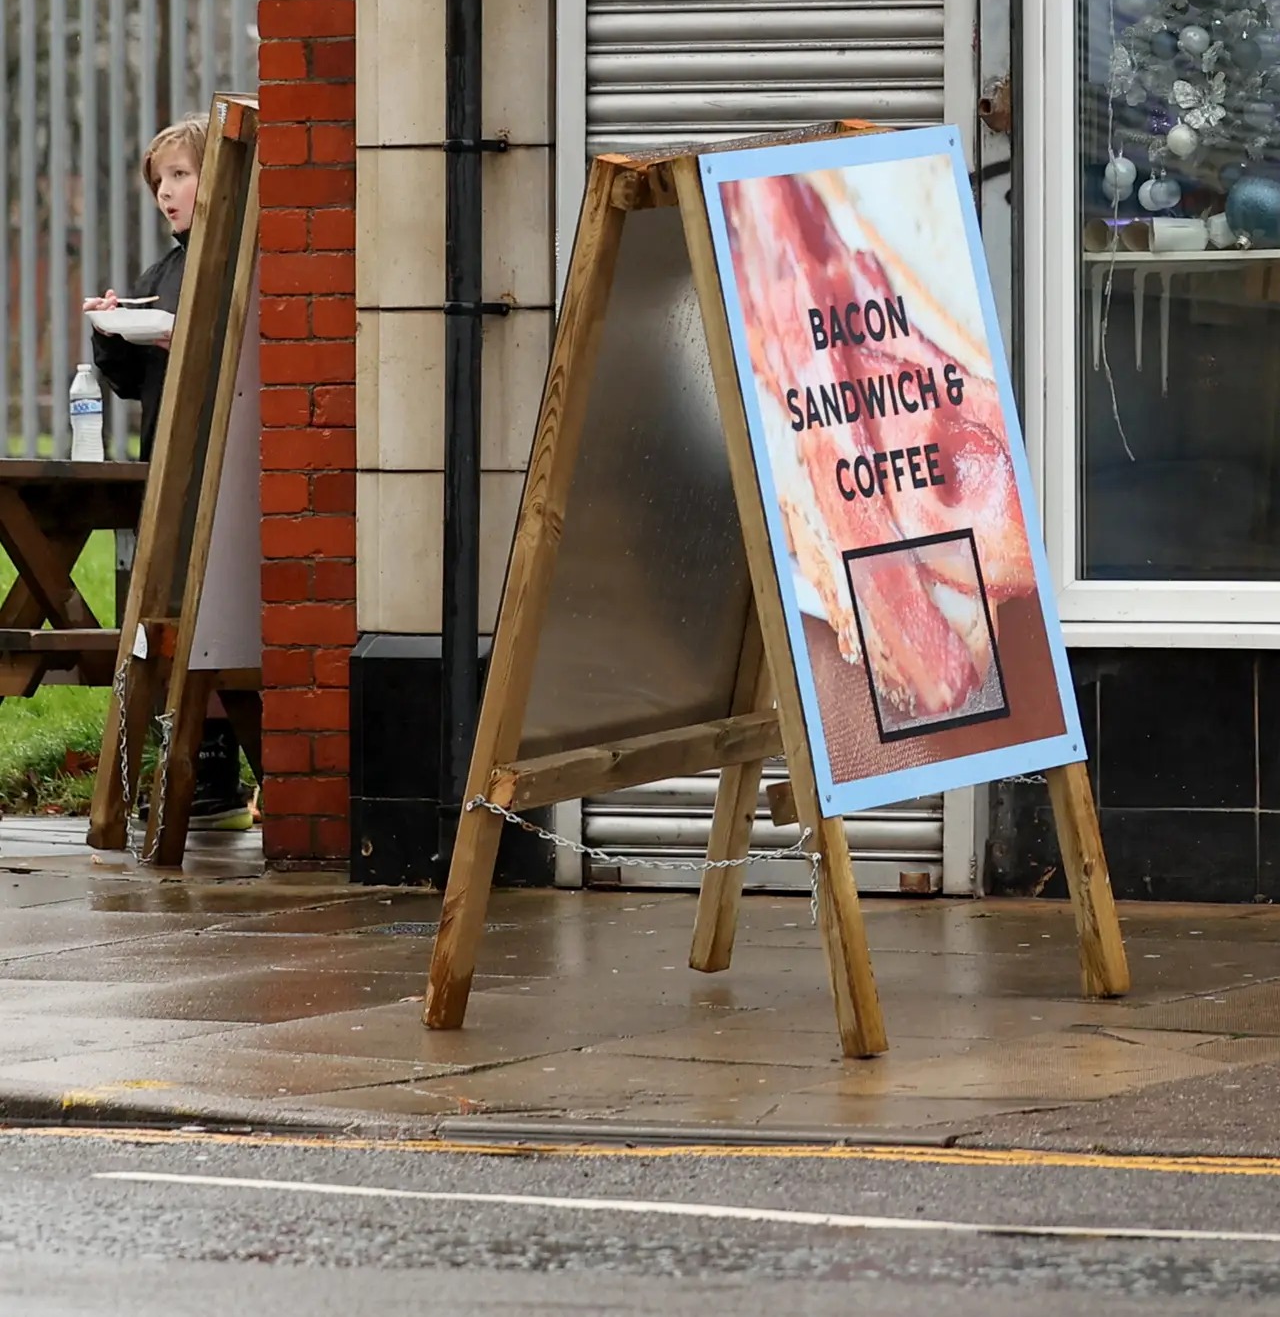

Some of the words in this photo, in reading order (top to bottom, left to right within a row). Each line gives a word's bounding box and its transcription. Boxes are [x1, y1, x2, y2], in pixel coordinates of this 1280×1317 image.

[807, 294, 909, 351] BACON
[786, 367, 941, 432] SANDWICH
[942, 363, 965, 405] &
[835, 442, 946, 502] COFFEE
